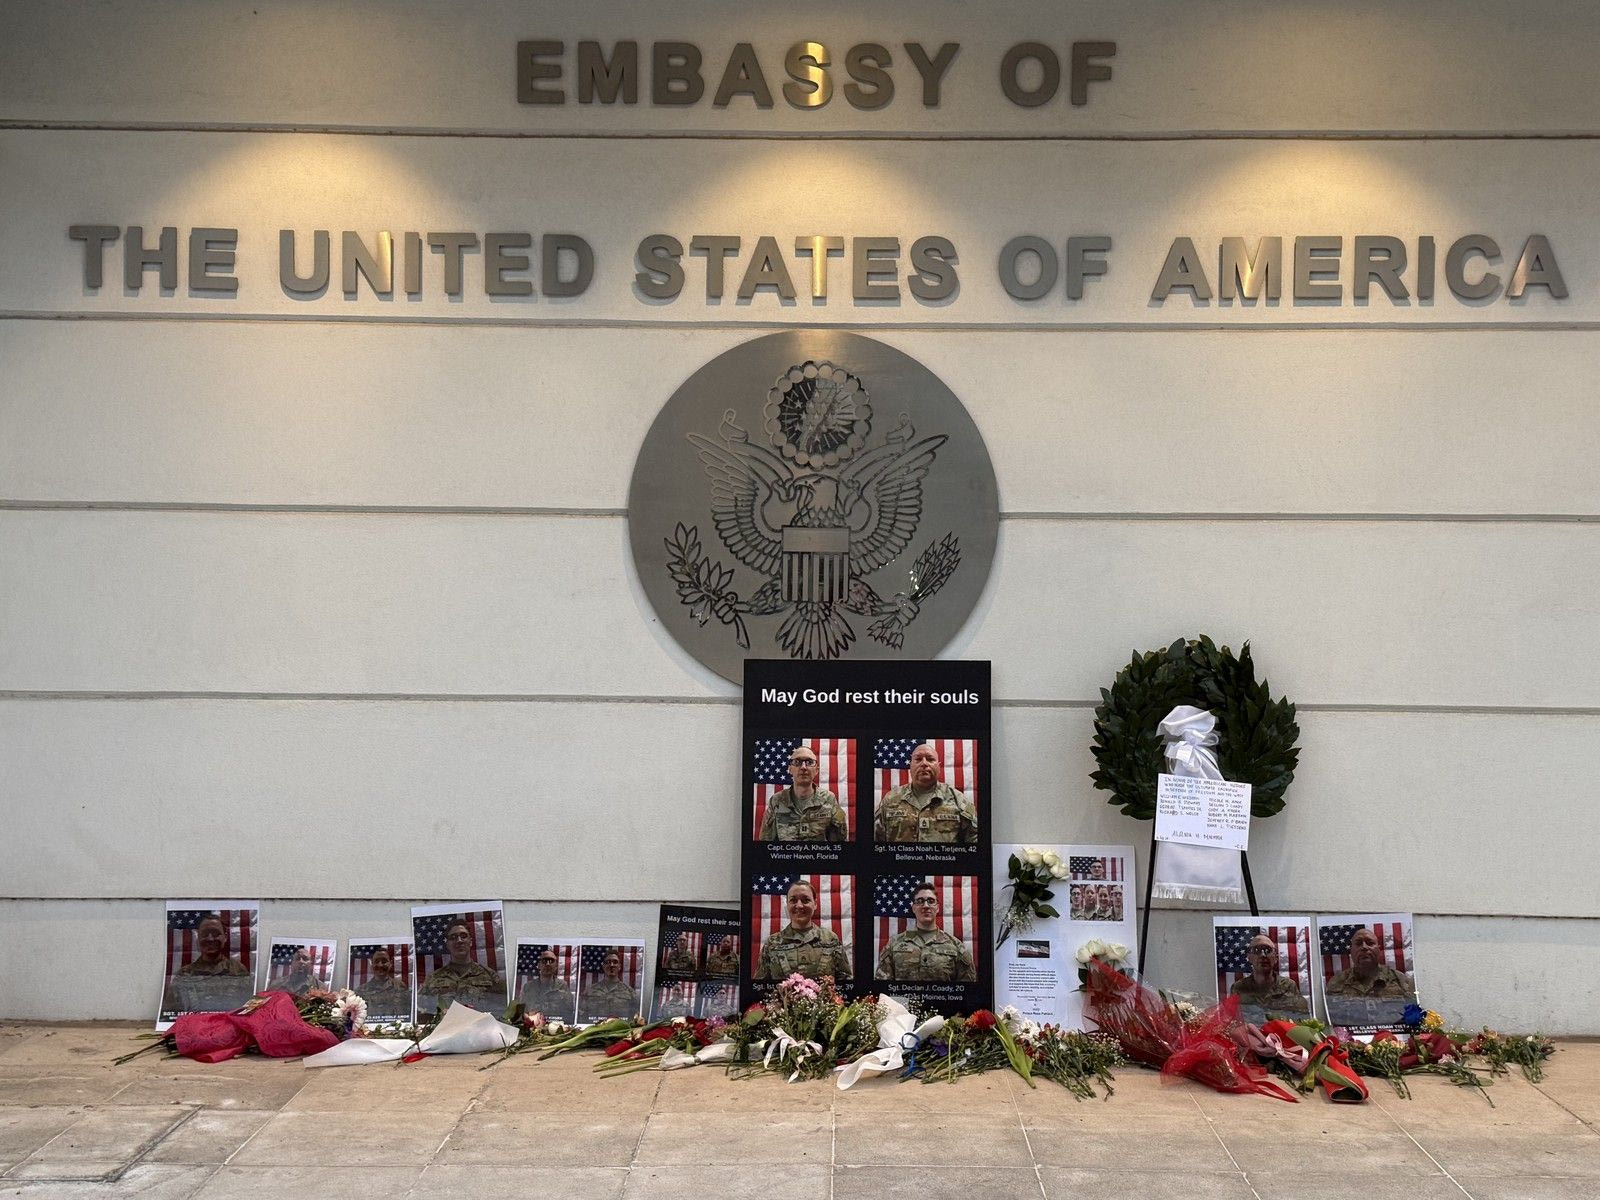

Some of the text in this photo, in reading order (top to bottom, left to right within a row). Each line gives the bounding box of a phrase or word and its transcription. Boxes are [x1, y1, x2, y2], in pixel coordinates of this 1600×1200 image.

[516, 41, 1116, 108] EMBASSY OF
[69, 225, 1569, 300] THE UNITED STATES OF AMERICA
[761, 688, 979, 706] May God rest their souls
[767, 843, 784, 851] Capt.
[785, 844, 802, 852] Cody
[811, 844, 832, 852] Khork,
[874, 845, 886, 853] Sgt.
[667, 915, 680, 923] May
